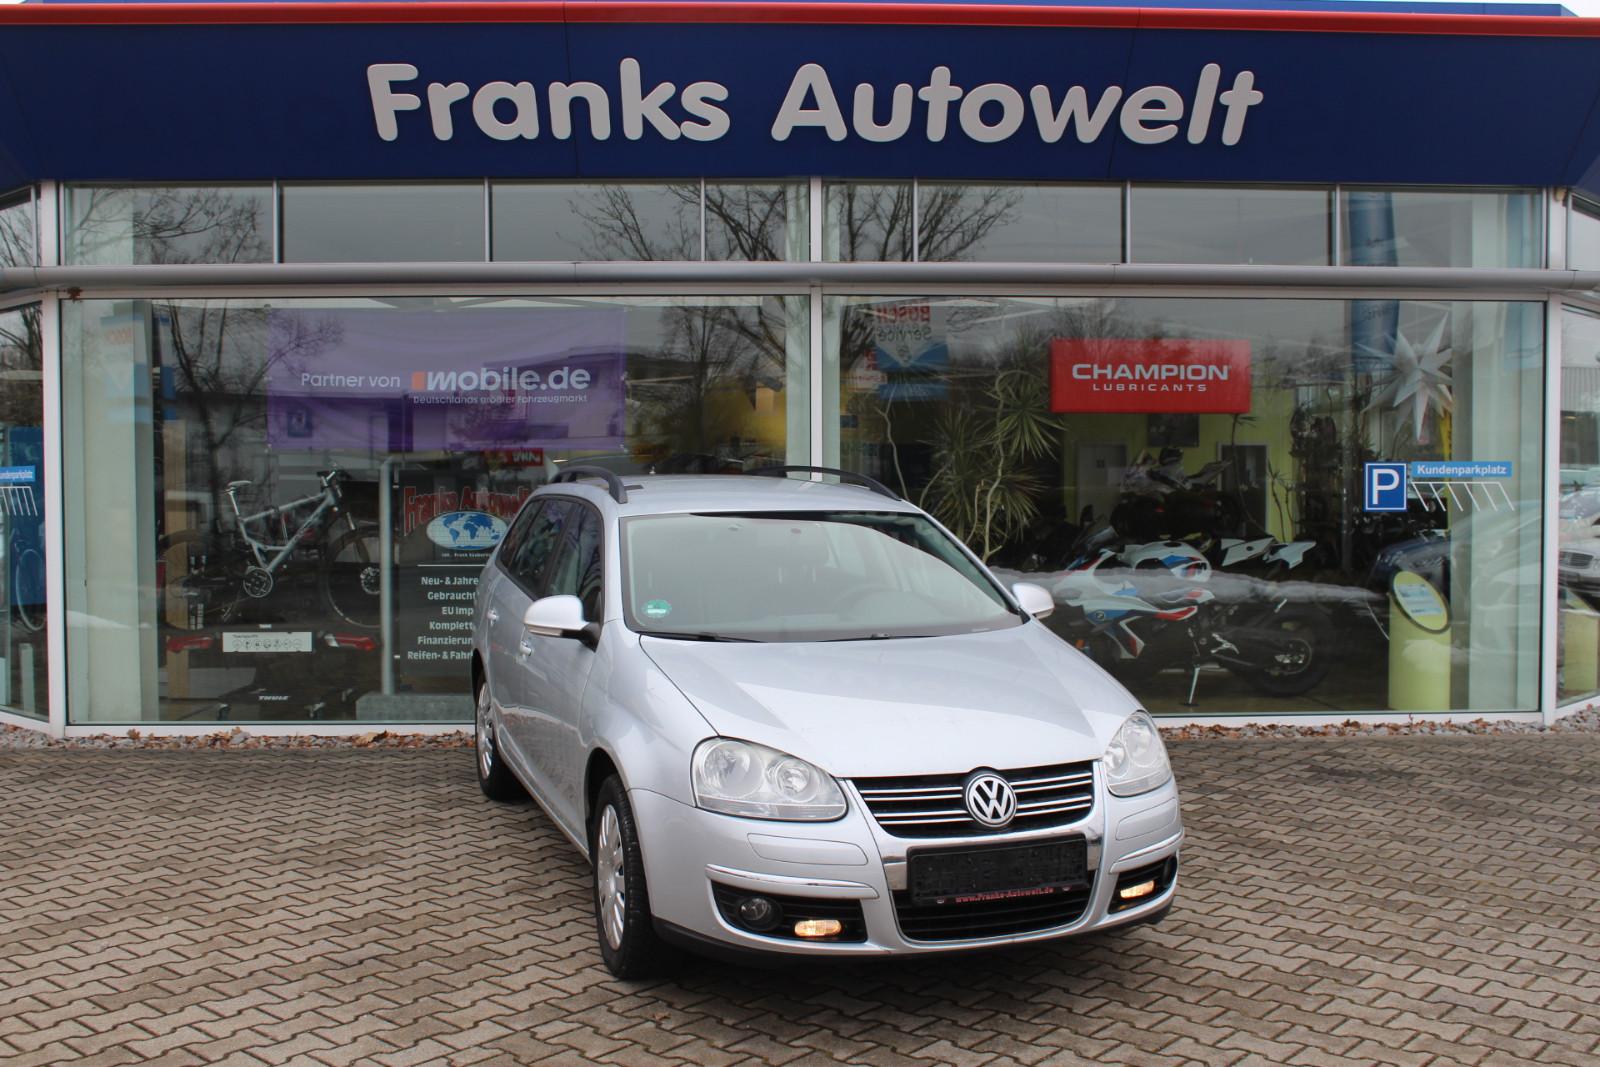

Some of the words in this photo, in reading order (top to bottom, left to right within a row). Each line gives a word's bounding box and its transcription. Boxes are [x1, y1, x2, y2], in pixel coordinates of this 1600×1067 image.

[367, 57, 731, 142] Franks
[771, 63, 1264, 146] Autowelt
[1072, 363, 1229, 381] CHAMPION
[301, 373, 364, 389] Partner
[369, 376, 401, 389] von
[426, 366, 591, 391] mobile.de
[1092, 384, 1208, 392] LUBRICANTS
[413, 395, 479, 405] Deutschlands
[517, 394, 588, 405] Fahrzeugmarkt
[1417, 464, 1508, 477] Kundenparkplatz
[1372, 469, 1400, 505] P
[421, 576, 443, 586] Neu-
[445, 576, 451, 586] &
[452, 576, 479, 586] Jahre
[427, 591, 480, 601] Gebraucht
[442, 606, 454, 616] EU
[407, 651, 441, 660] Reifen-
[442, 651, 449, 660] &
[451, 651, 473, 660] Fahr
